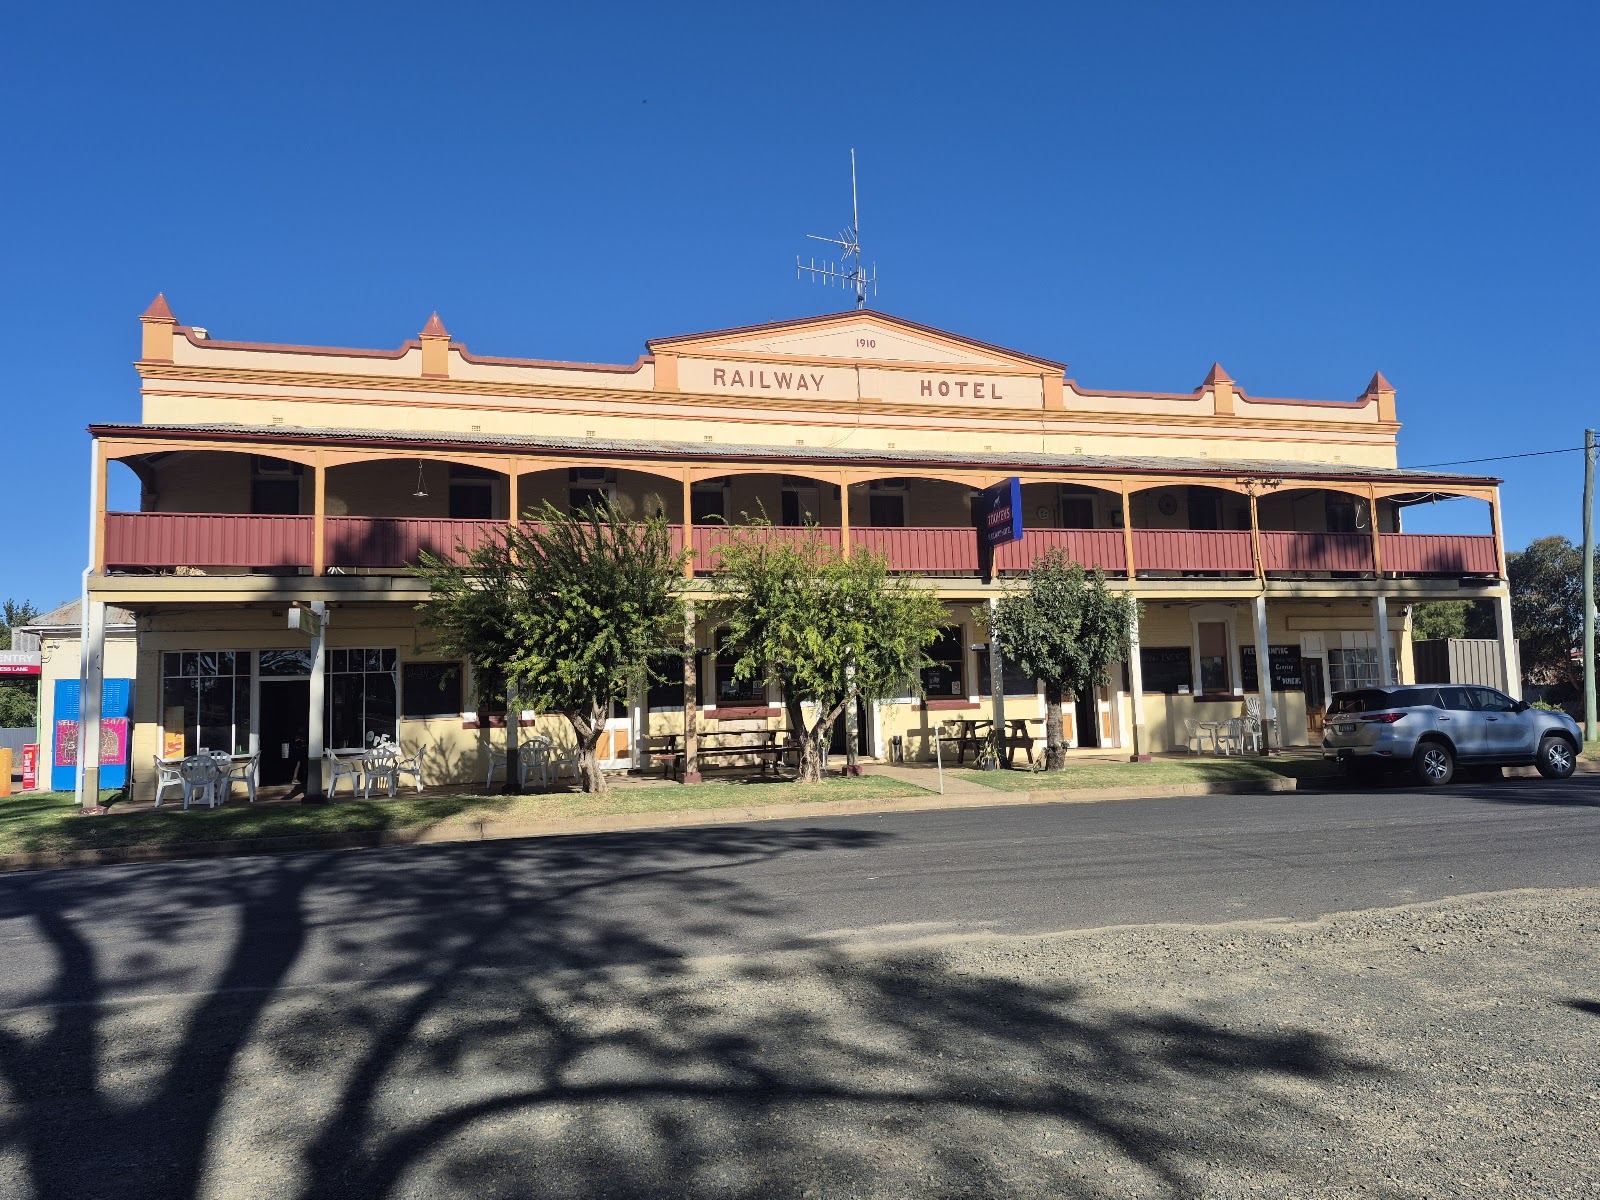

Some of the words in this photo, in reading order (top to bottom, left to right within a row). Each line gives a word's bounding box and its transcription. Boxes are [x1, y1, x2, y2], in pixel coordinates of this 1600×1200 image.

[856, 338, 876, 348] 1910
[713, 367, 824, 391] RAILWAY
[920, 379, 1003, 400] HOTEL
[987, 507, 1010, 526] TOOHEYS
[366, 730, 391, 746] OPE
